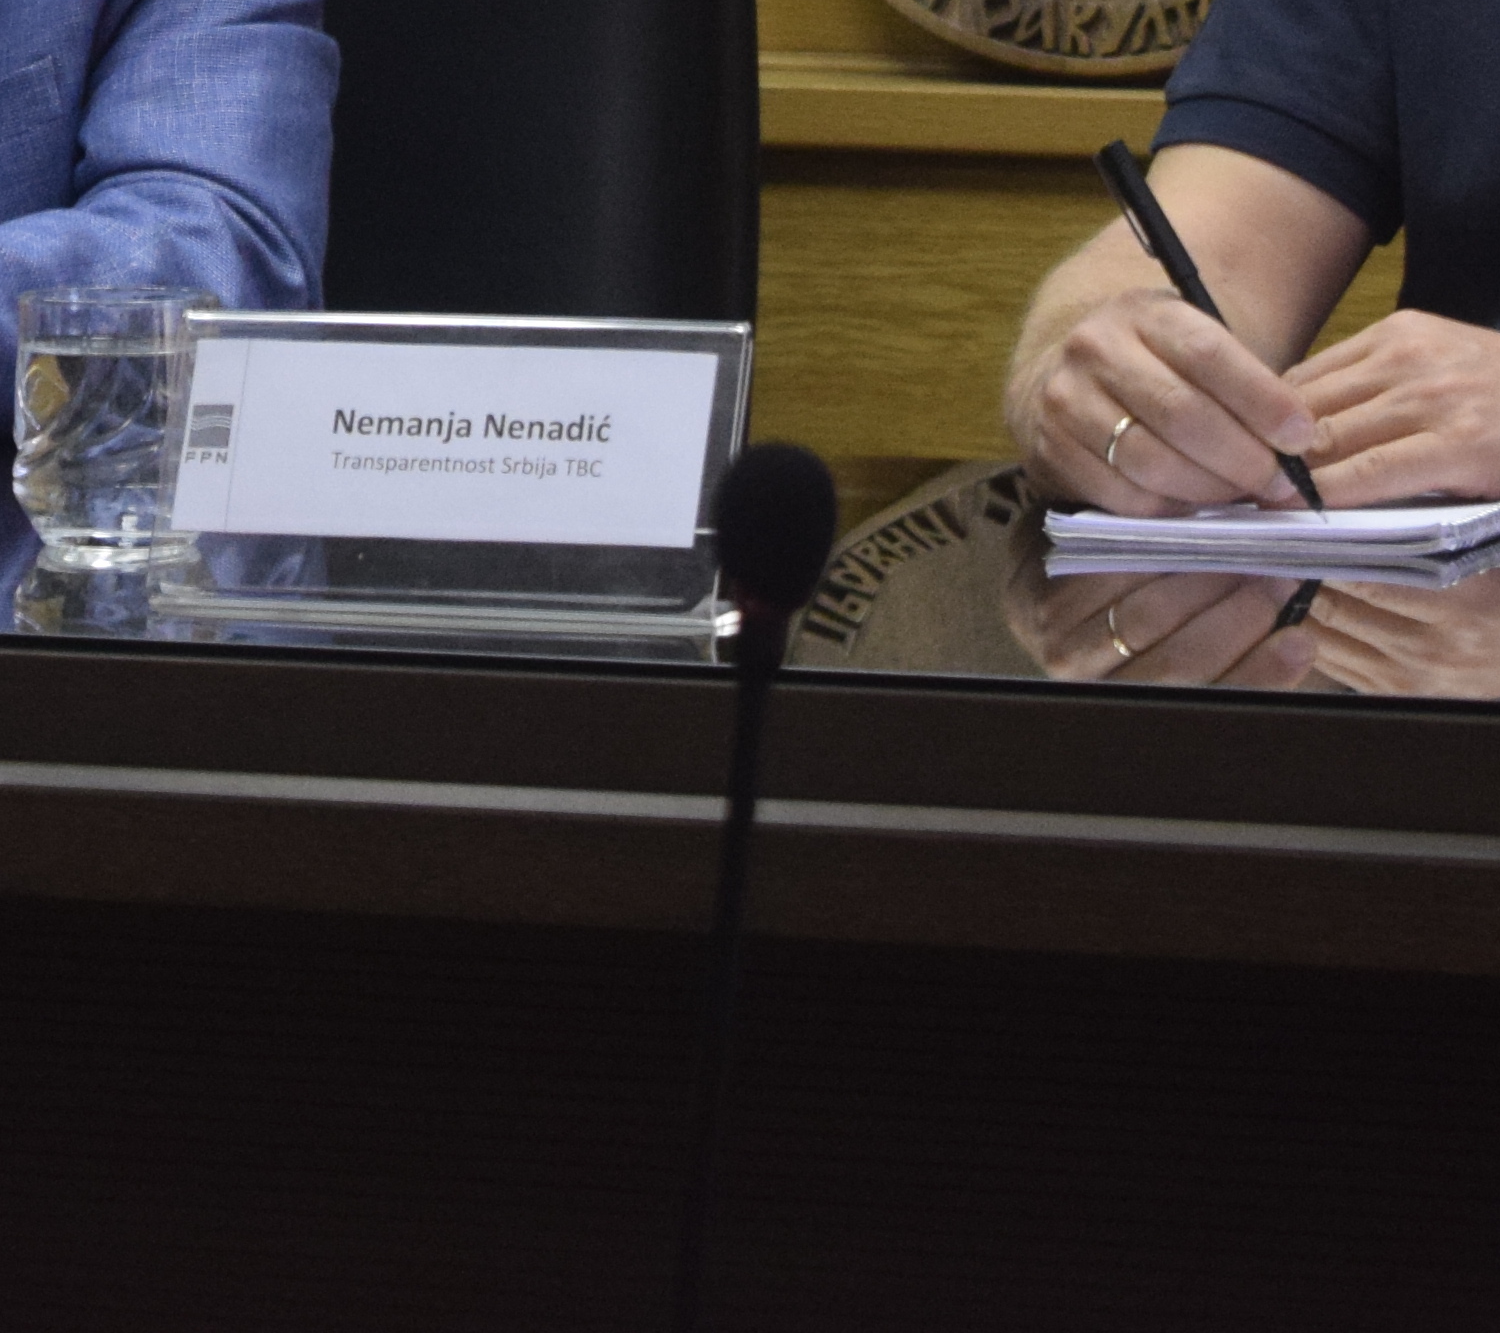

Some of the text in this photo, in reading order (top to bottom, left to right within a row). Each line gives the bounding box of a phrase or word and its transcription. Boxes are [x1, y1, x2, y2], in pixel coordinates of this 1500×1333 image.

[332, 409, 613, 444] Nemanja Nenadić
[184, 451, 228, 464] FPN
[331, 450, 603, 480] Transparentnost Srbija TBC
